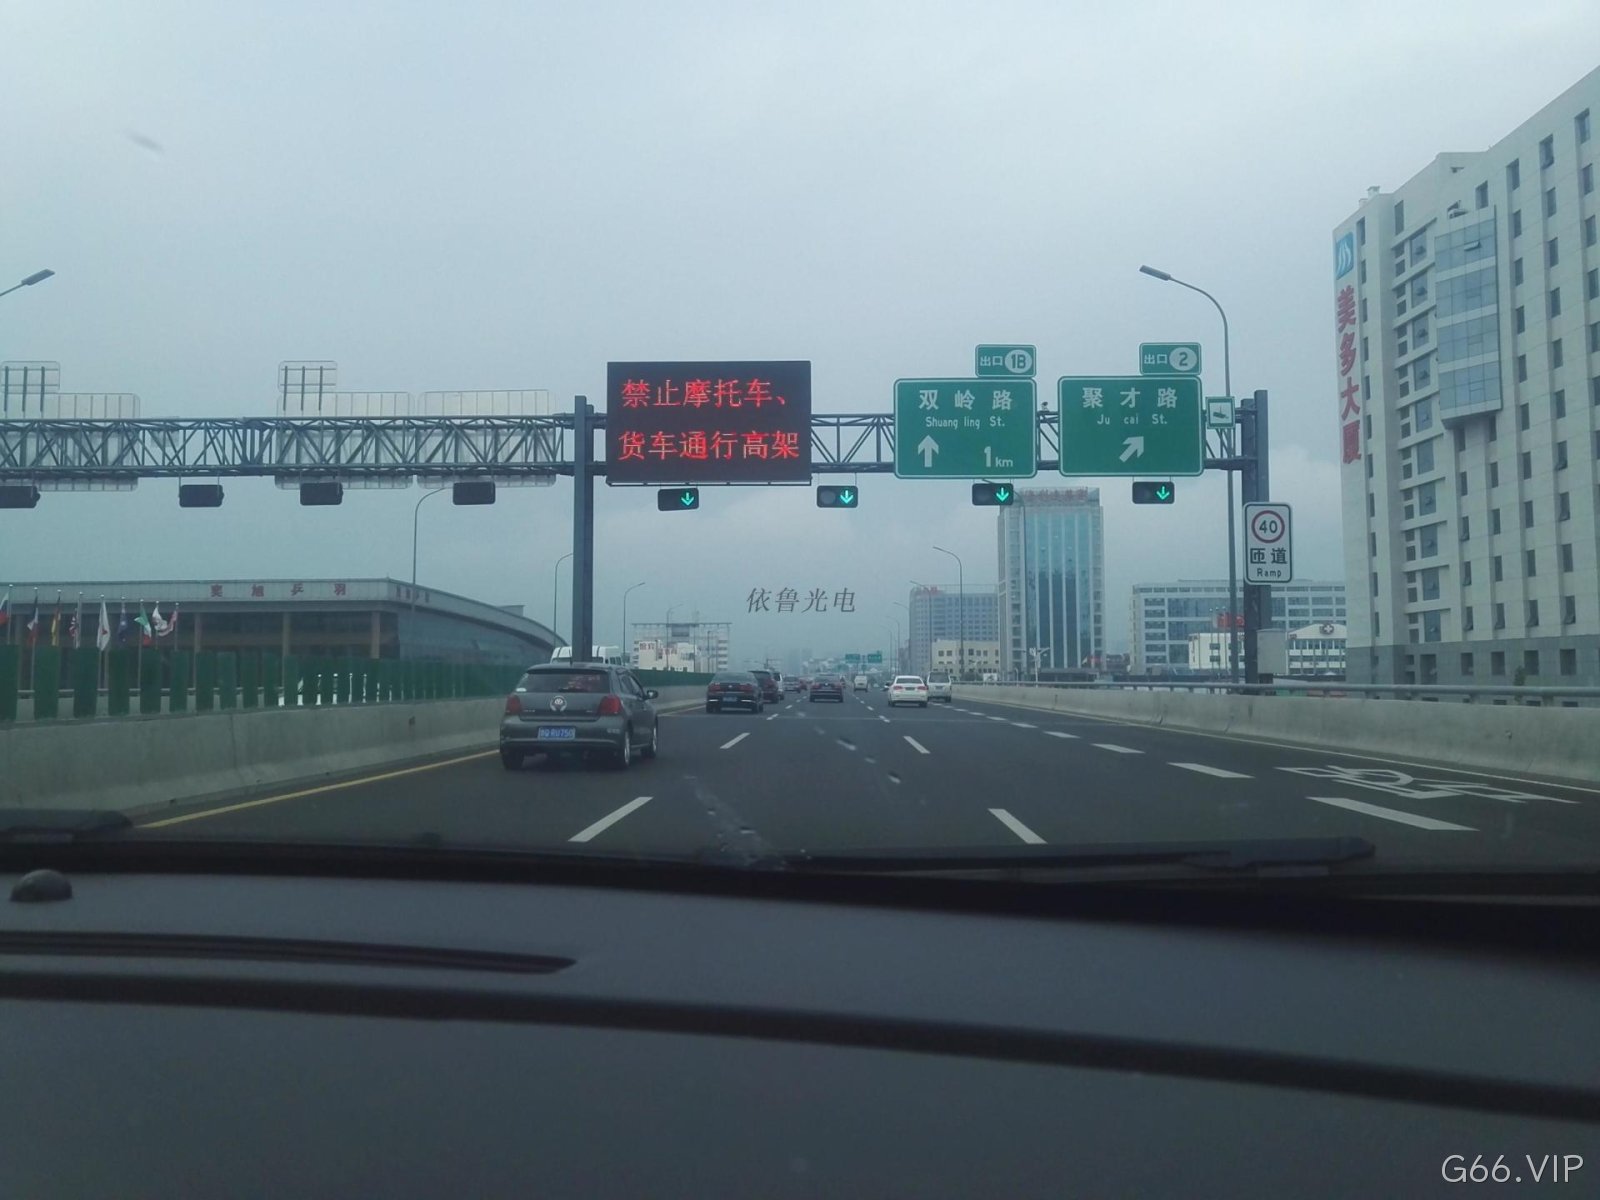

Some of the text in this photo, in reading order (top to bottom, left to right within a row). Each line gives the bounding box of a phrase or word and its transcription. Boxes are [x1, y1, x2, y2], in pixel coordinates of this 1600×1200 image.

[979, 353, 1027, 369] 出口 1B
[1143, 351, 1189, 367] 出口 2
[1337, 285, 1362, 464] 美多大厦
[621, 378, 786, 408] 禁止摩托车、
[918, 389, 1013, 411] 双岭路
[1081, 387, 1178, 409] 聚才路
[925, 416, 959, 430] Shuang
[989, 415, 1006, 428] St.
[1097, 413, 1168, 425] Ju cai St.
[618, 430, 800, 460] 货车通行高架
[1259, 519, 1278, 534] 40
[1250, 547, 1288, 565] 匝道
[1256, 567, 1282, 579] Ramp
